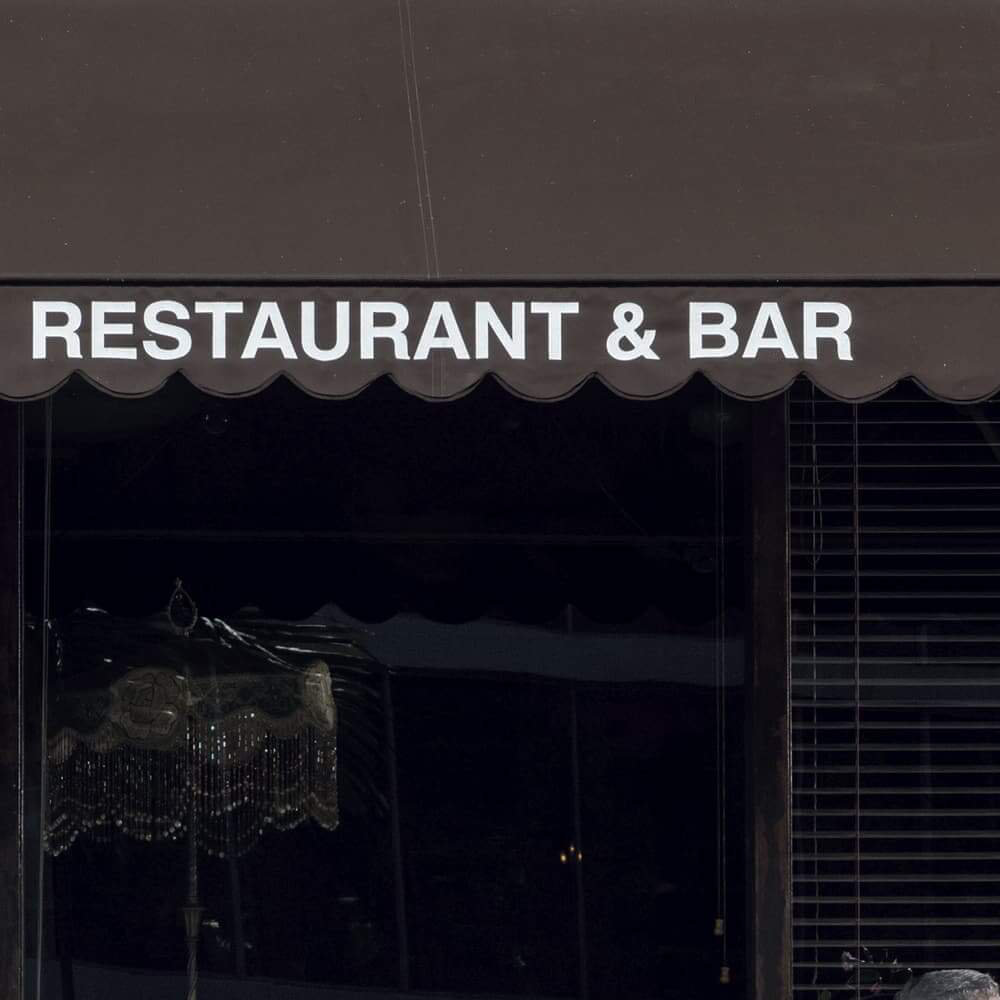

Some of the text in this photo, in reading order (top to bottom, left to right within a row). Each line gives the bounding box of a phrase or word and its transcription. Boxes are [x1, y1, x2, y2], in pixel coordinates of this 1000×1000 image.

[31, 300, 854, 362] RESTAURANT & BAR
